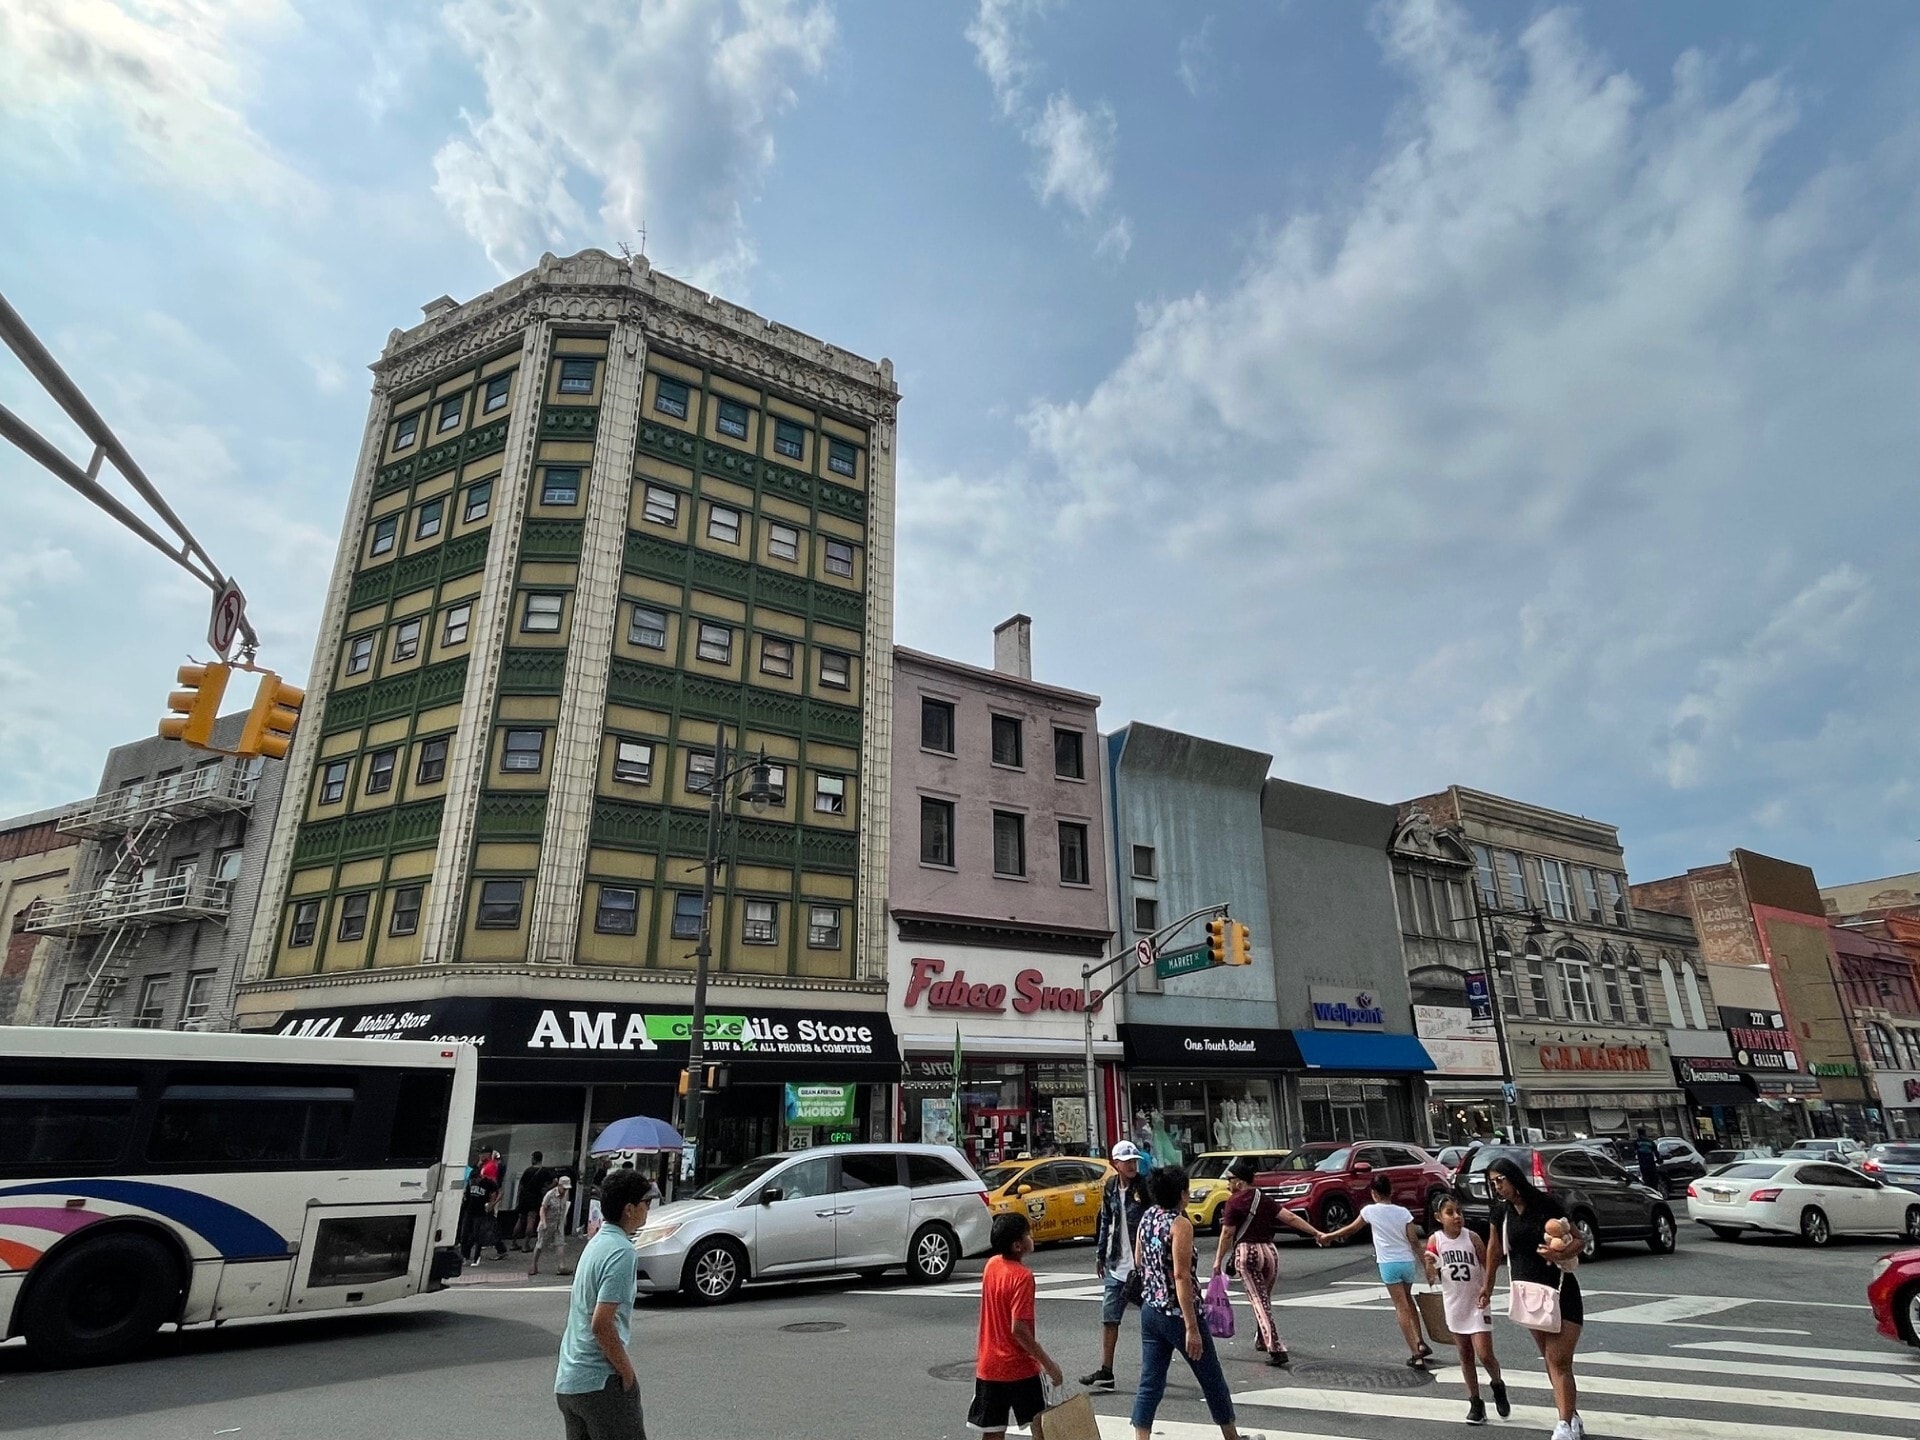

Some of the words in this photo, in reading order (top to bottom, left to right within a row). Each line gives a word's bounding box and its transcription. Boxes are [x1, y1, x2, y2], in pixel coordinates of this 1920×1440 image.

[1168, 953, 1193, 969] MARKET
[904, 958, 1007, 1008] Fabco
[352, 1013, 397, 1033] Mobile
[396, 1011, 432, 1029] Store
[1313, 1002, 1385, 1027] Wellpoint
[1750, 1012, 1765, 1025] 222
[527, 1010, 658, 1050] AMA
[752, 1017, 789, 1041] ile
[797, 1019, 873, 1042] Store
[712, 1041, 731, 1051] BUY
[732, 1041, 741, 1051] &
[1184, 1038, 1203, 1051] One
[1203, 1038, 1228, 1051] Touch
[1229, 1039, 1256, 1051] Bridal
[1730, 1027, 1794, 1050] FURNITURE
[760, 1043, 778, 1052] ALL
[778, 1043, 812, 1053] PHONES
[813, 1044, 821, 1052] &
[822, 1044, 873, 1054] COMPUTERS
[1753, 1053, 1785, 1067] GALLERY
[797, 1106, 846, 1118] AHORROS
[830, 1132, 852, 1143] OPEN
[1442, 1249, 1475, 1267] JORDAN
[1449, 1264, 1471, 1282] 23
